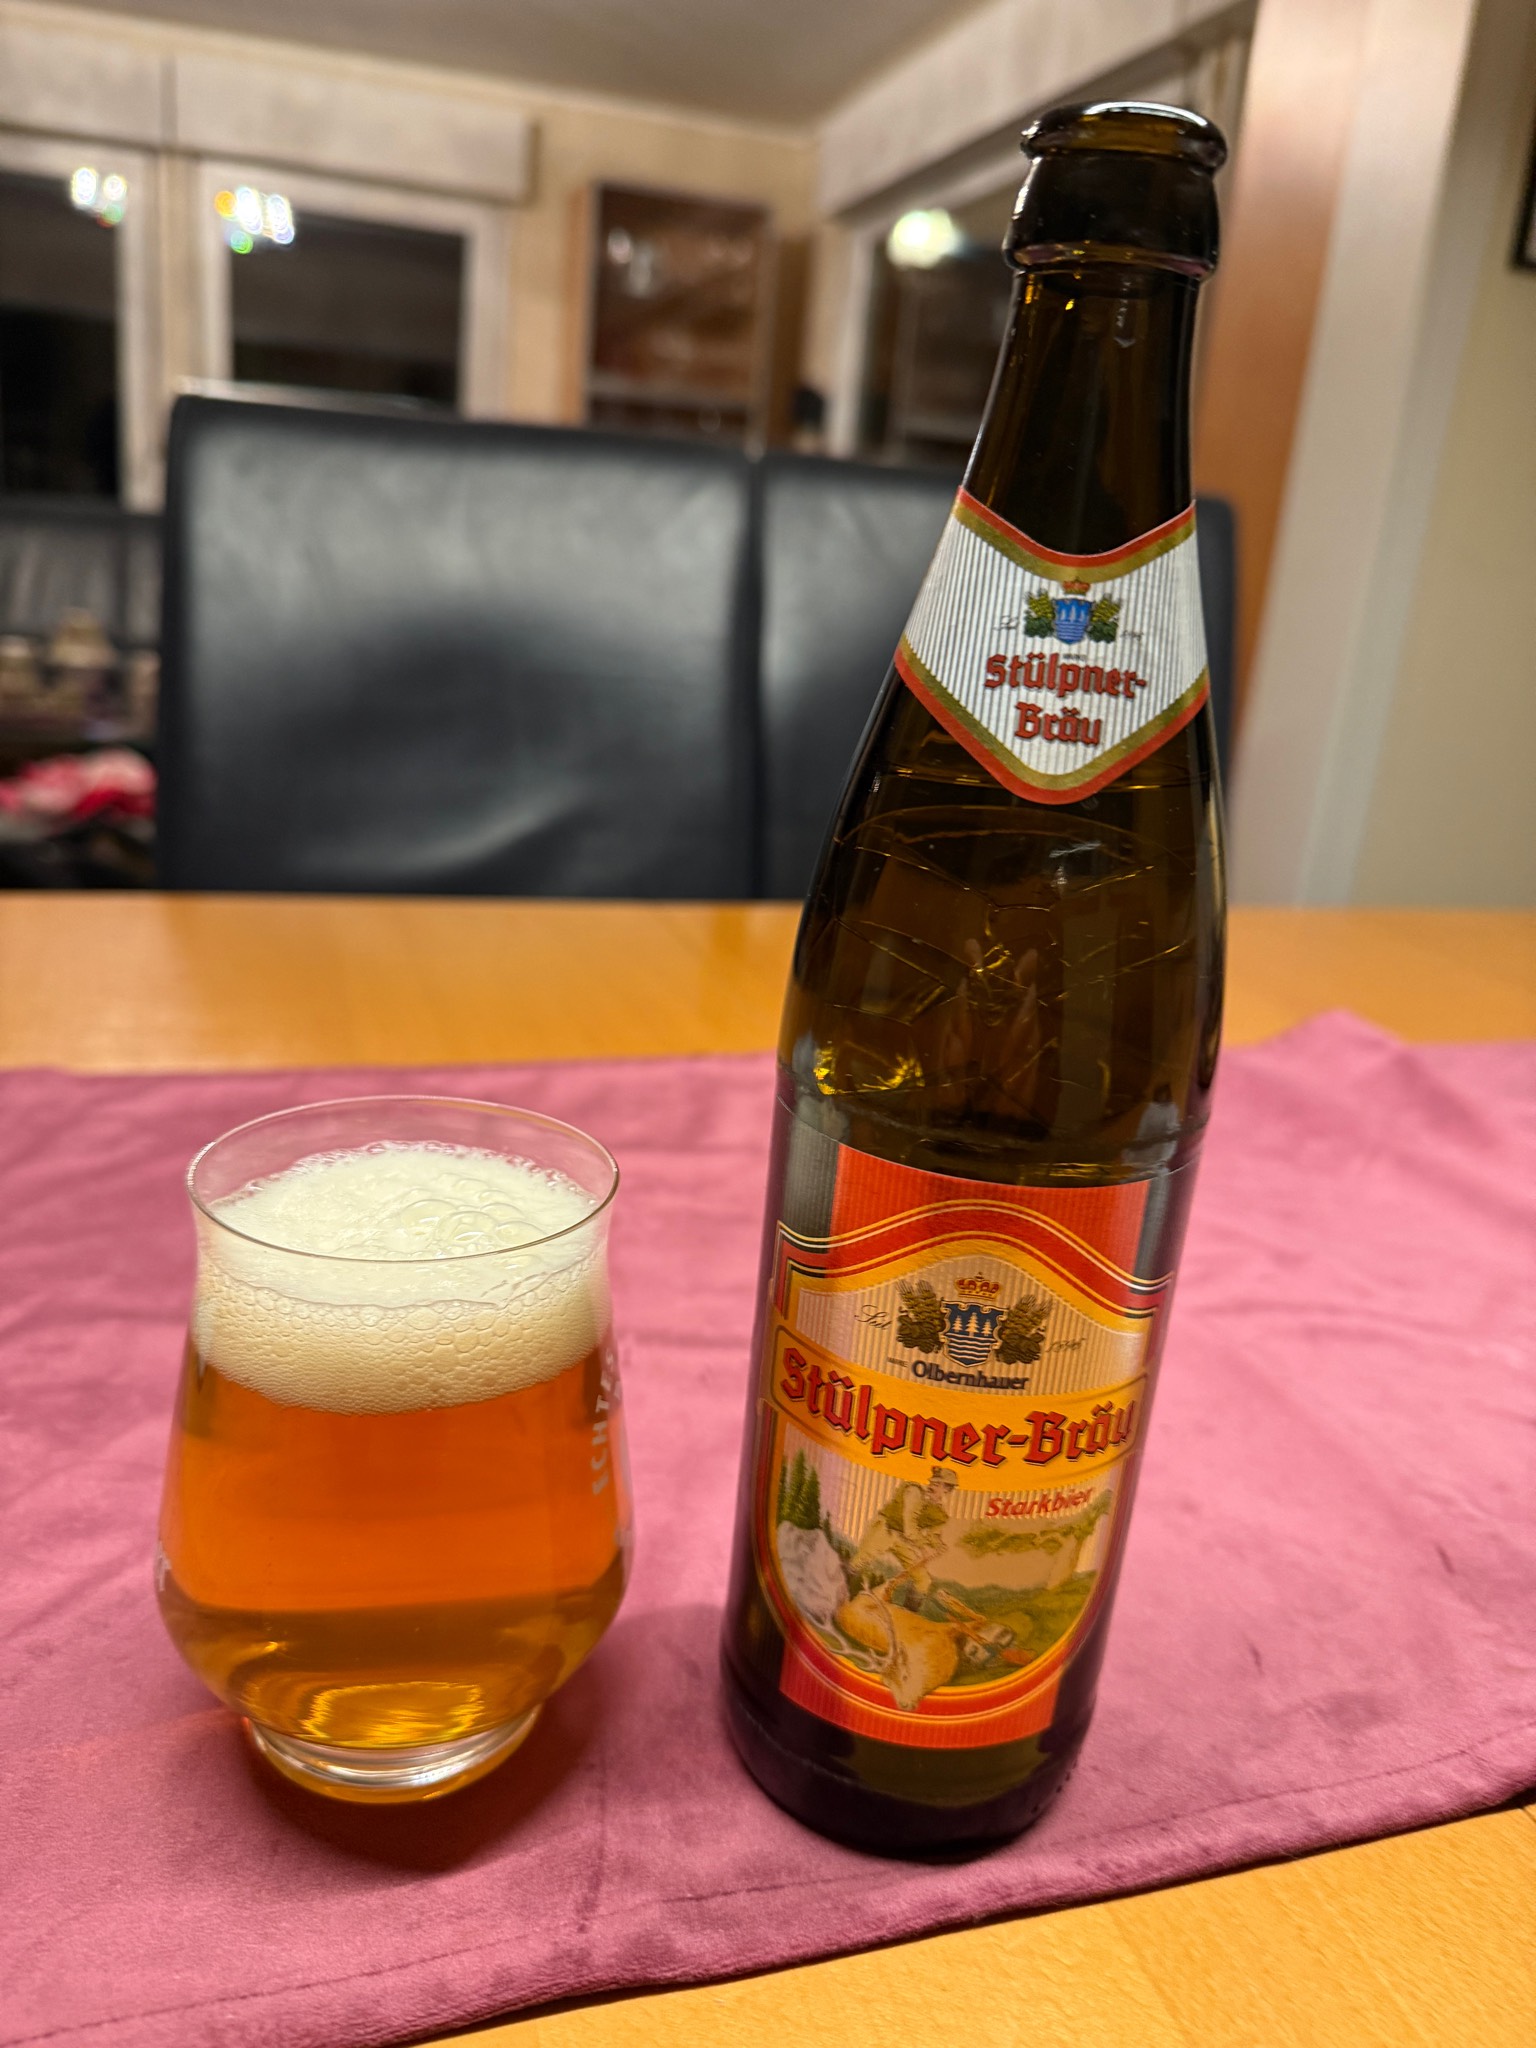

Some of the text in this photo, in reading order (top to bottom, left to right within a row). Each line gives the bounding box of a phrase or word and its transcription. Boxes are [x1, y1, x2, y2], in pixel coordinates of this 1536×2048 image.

[983, 652, 1147, 699] Stülpner-
[1014, 701, 1103, 746] Bräu
[911, 1359, 1030, 1390] Olbernhauer
[780, 1346, 1136, 1469] Stülpner-Bräu
[984, 1486, 1094, 1518] Starkbier
